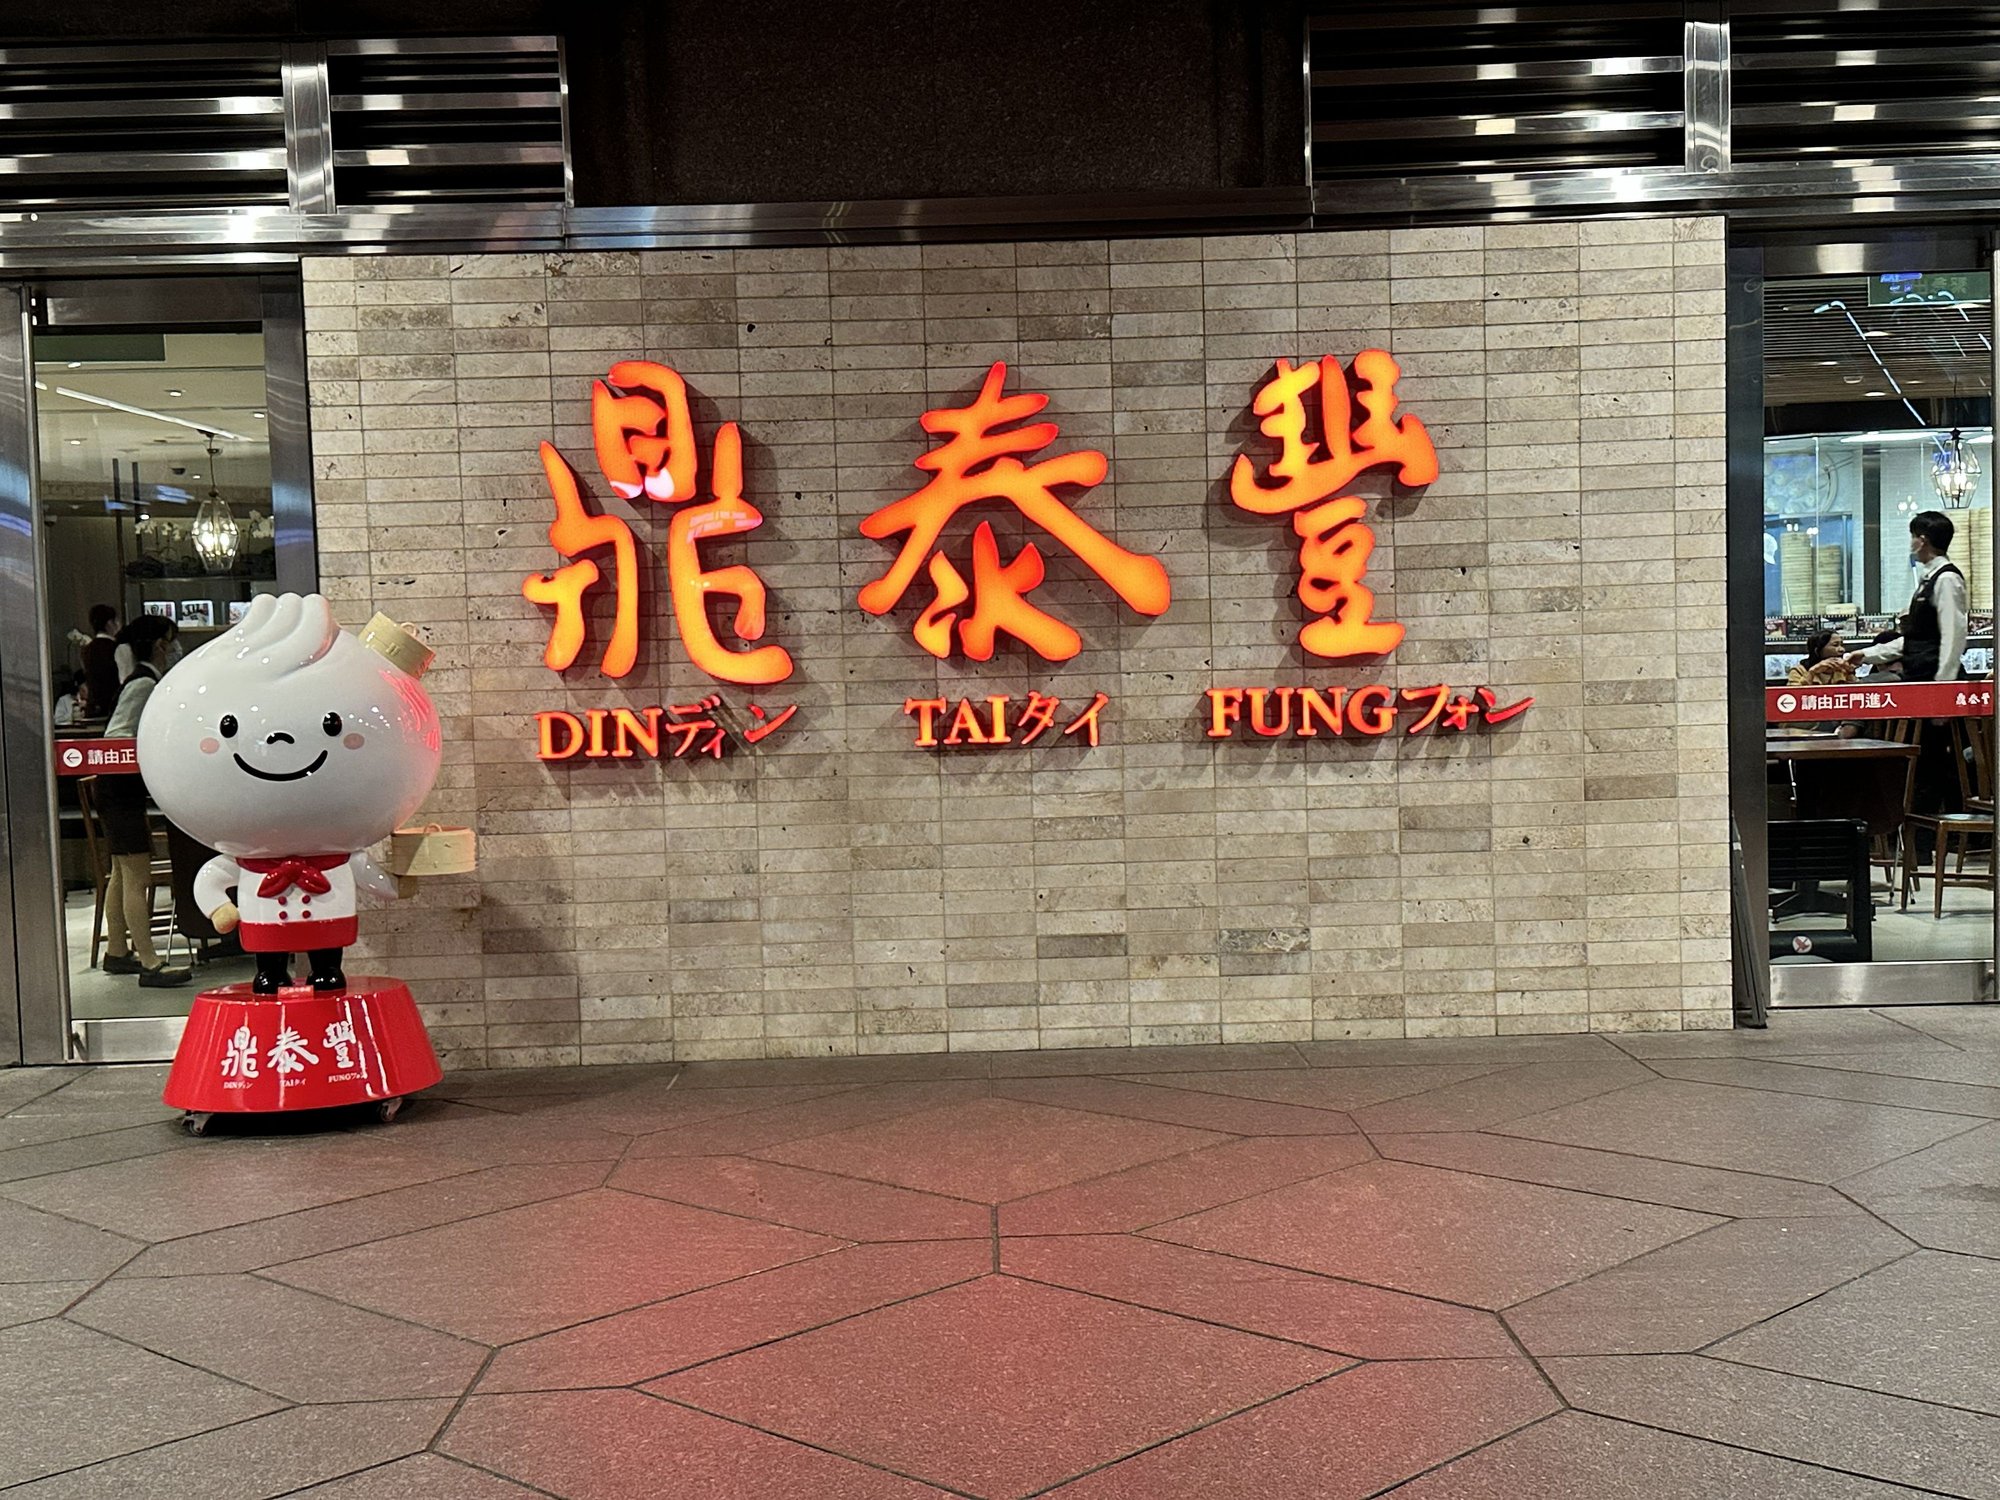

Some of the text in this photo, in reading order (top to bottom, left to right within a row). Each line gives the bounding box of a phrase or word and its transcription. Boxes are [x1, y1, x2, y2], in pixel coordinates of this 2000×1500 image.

[522, 348, 1439, 684] 鼎泰豐
[1801, 693, 1898, 711] 請由正門進入
[87, 748, 136, 765] 請由正
[220, 1020, 357, 1079] 鼎泰豐
